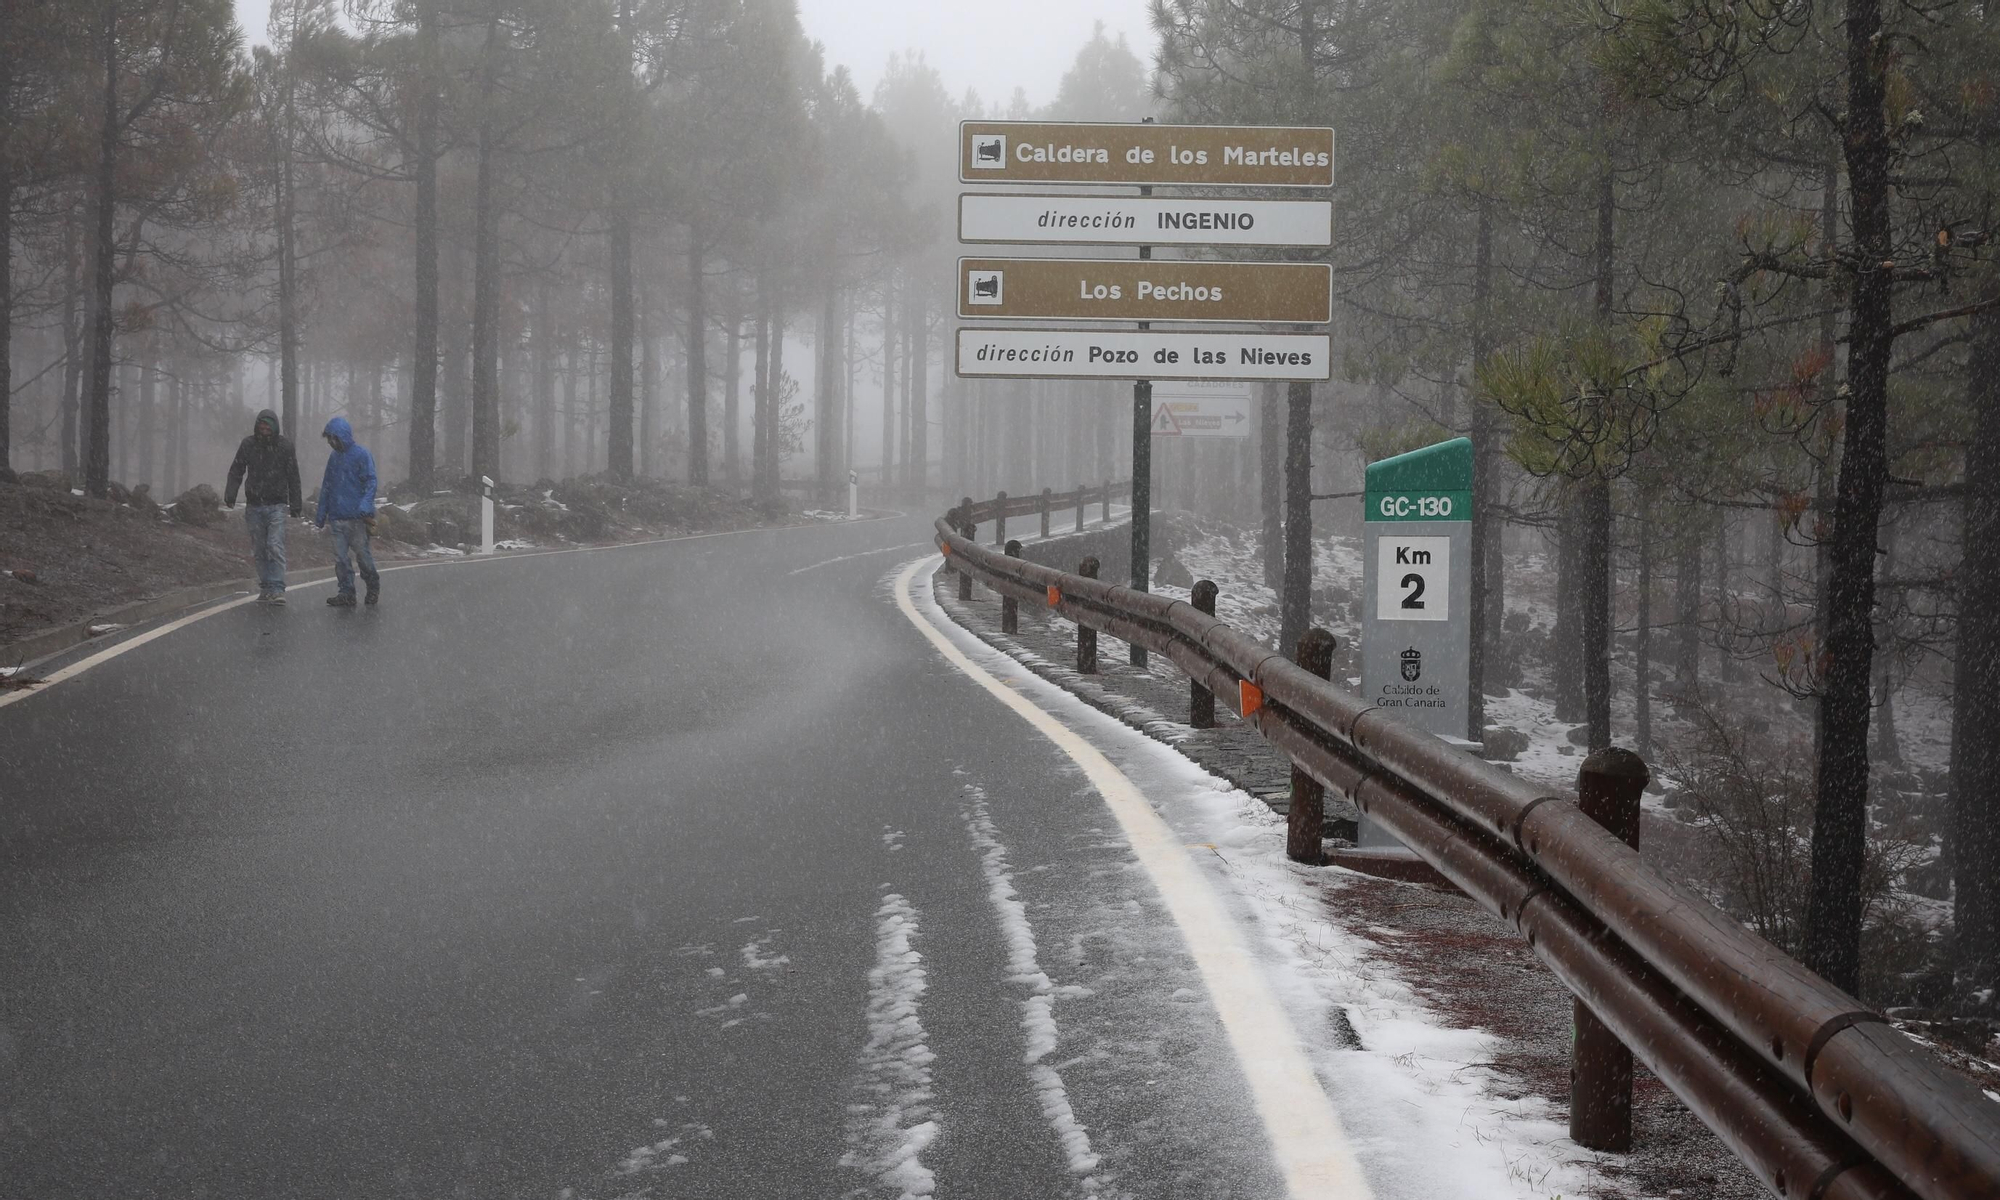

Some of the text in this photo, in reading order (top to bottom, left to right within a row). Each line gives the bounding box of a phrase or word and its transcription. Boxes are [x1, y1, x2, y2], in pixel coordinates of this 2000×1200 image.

[1015, 143, 1329, 167] Caldera de los Marteles
[1038, 210, 1254, 230] dirección INGENIO
[1080, 280, 1223, 301] Los Pechos
[976, 345, 1312, 366] dirección Pozo de las Nieves
[1380, 496, 1452, 517] GC-130
[1396, 546, 1431, 565] Km
[1400, 573, 1425, 609] 2
[1383, 684, 1440, 696] Cabildo de
[1377, 696, 1446, 709] Gran Canaria
